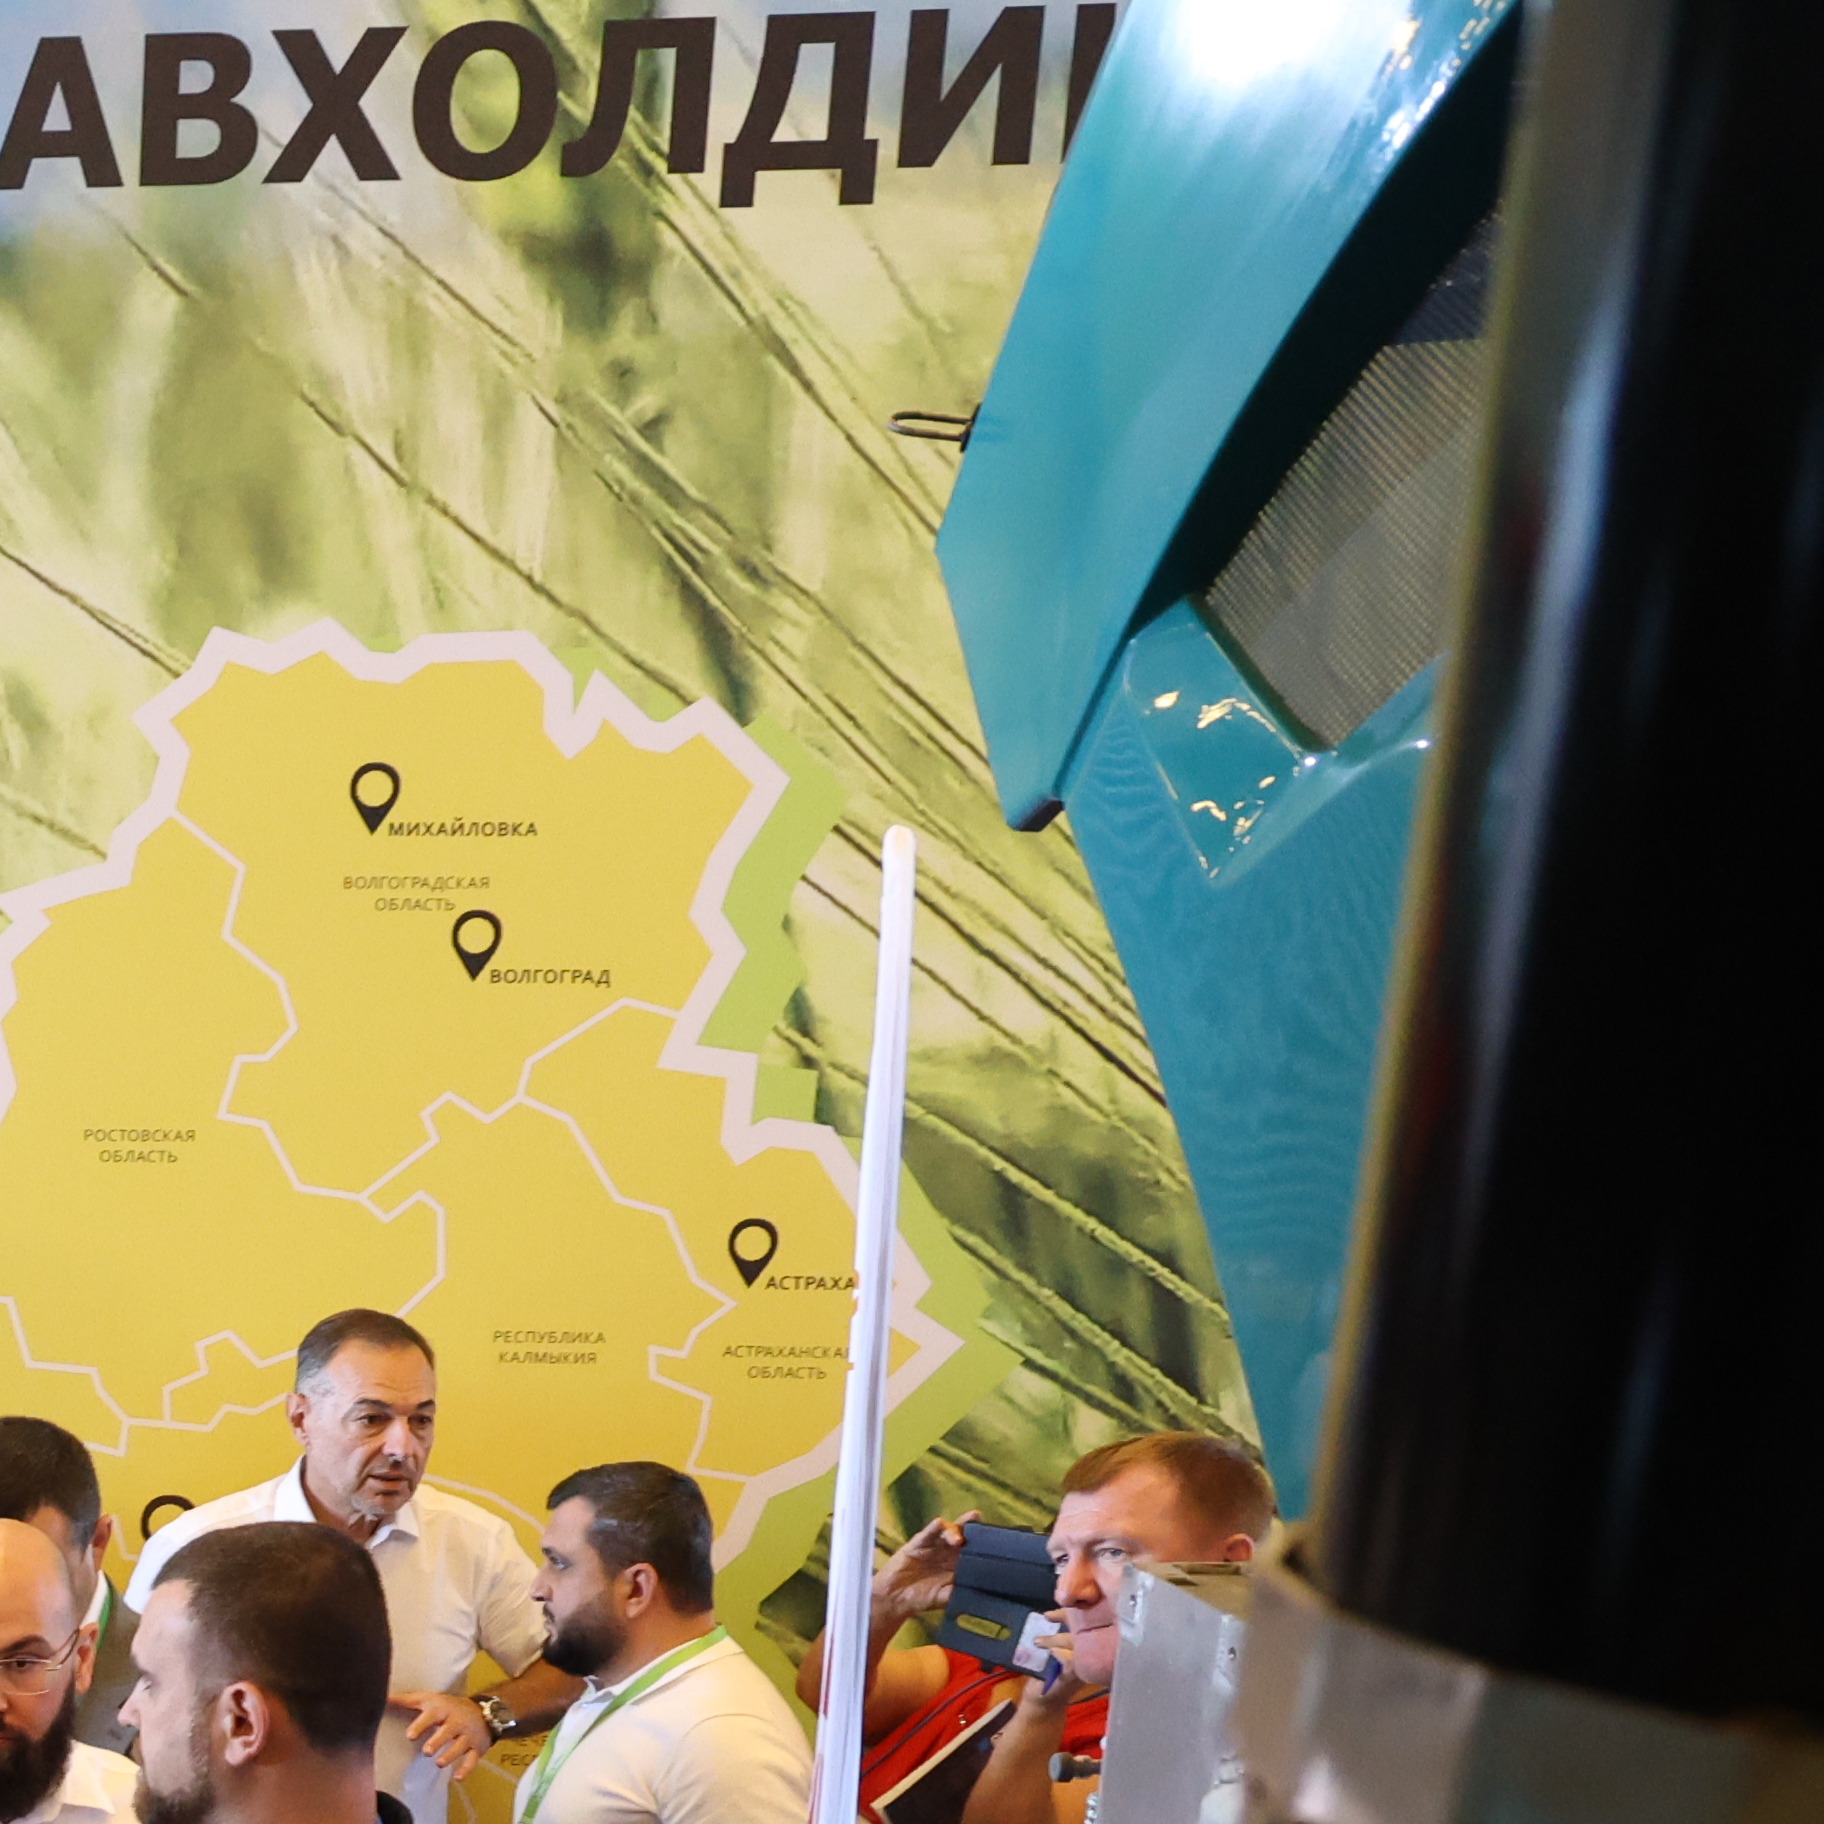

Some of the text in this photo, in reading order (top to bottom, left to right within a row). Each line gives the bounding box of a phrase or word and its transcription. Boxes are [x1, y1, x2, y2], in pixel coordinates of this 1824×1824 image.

[387, 817, 538, 837] МИХАЙЛОВКА
[343, 876, 490, 892] ВОЛГОГРАДСКАЯ
[374, 897, 456, 911] ОБЛАСТЬ
[489, 969, 612, 988] ВОЛГОГРАД
[83, 1128, 196, 1142] РОСТОВСКАЯ
[99, 1150, 178, 1163] ОБЛАСТЬ
[764, 1275, 857, 1291] АСТРАХА
[493, 1330, 606, 1345] РЕСПУБЛИКА
[498, 1351, 597, 1365] КАЛМЫКИЯ
[746, 1366, 827, 1380] ОБЛАСТЬ
